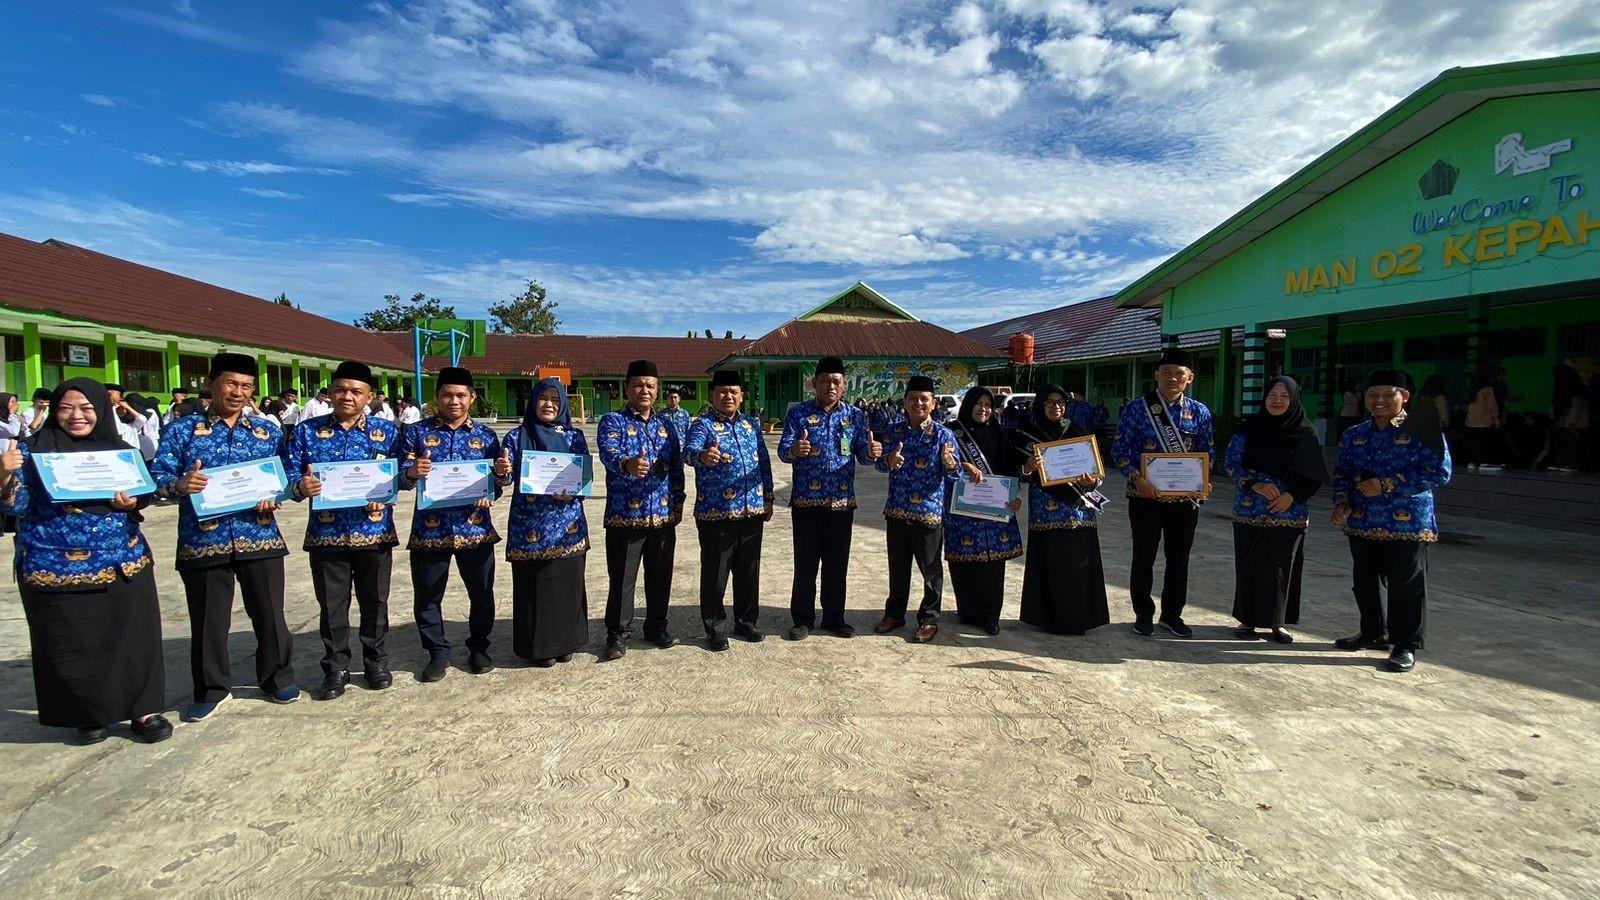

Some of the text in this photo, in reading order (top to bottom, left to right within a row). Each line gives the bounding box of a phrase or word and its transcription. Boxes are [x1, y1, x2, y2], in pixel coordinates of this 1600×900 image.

[1550, 174, 1585, 202] To
[1284, 258, 1357, 296] MAN
[1371, 243, 1424, 280] 02
